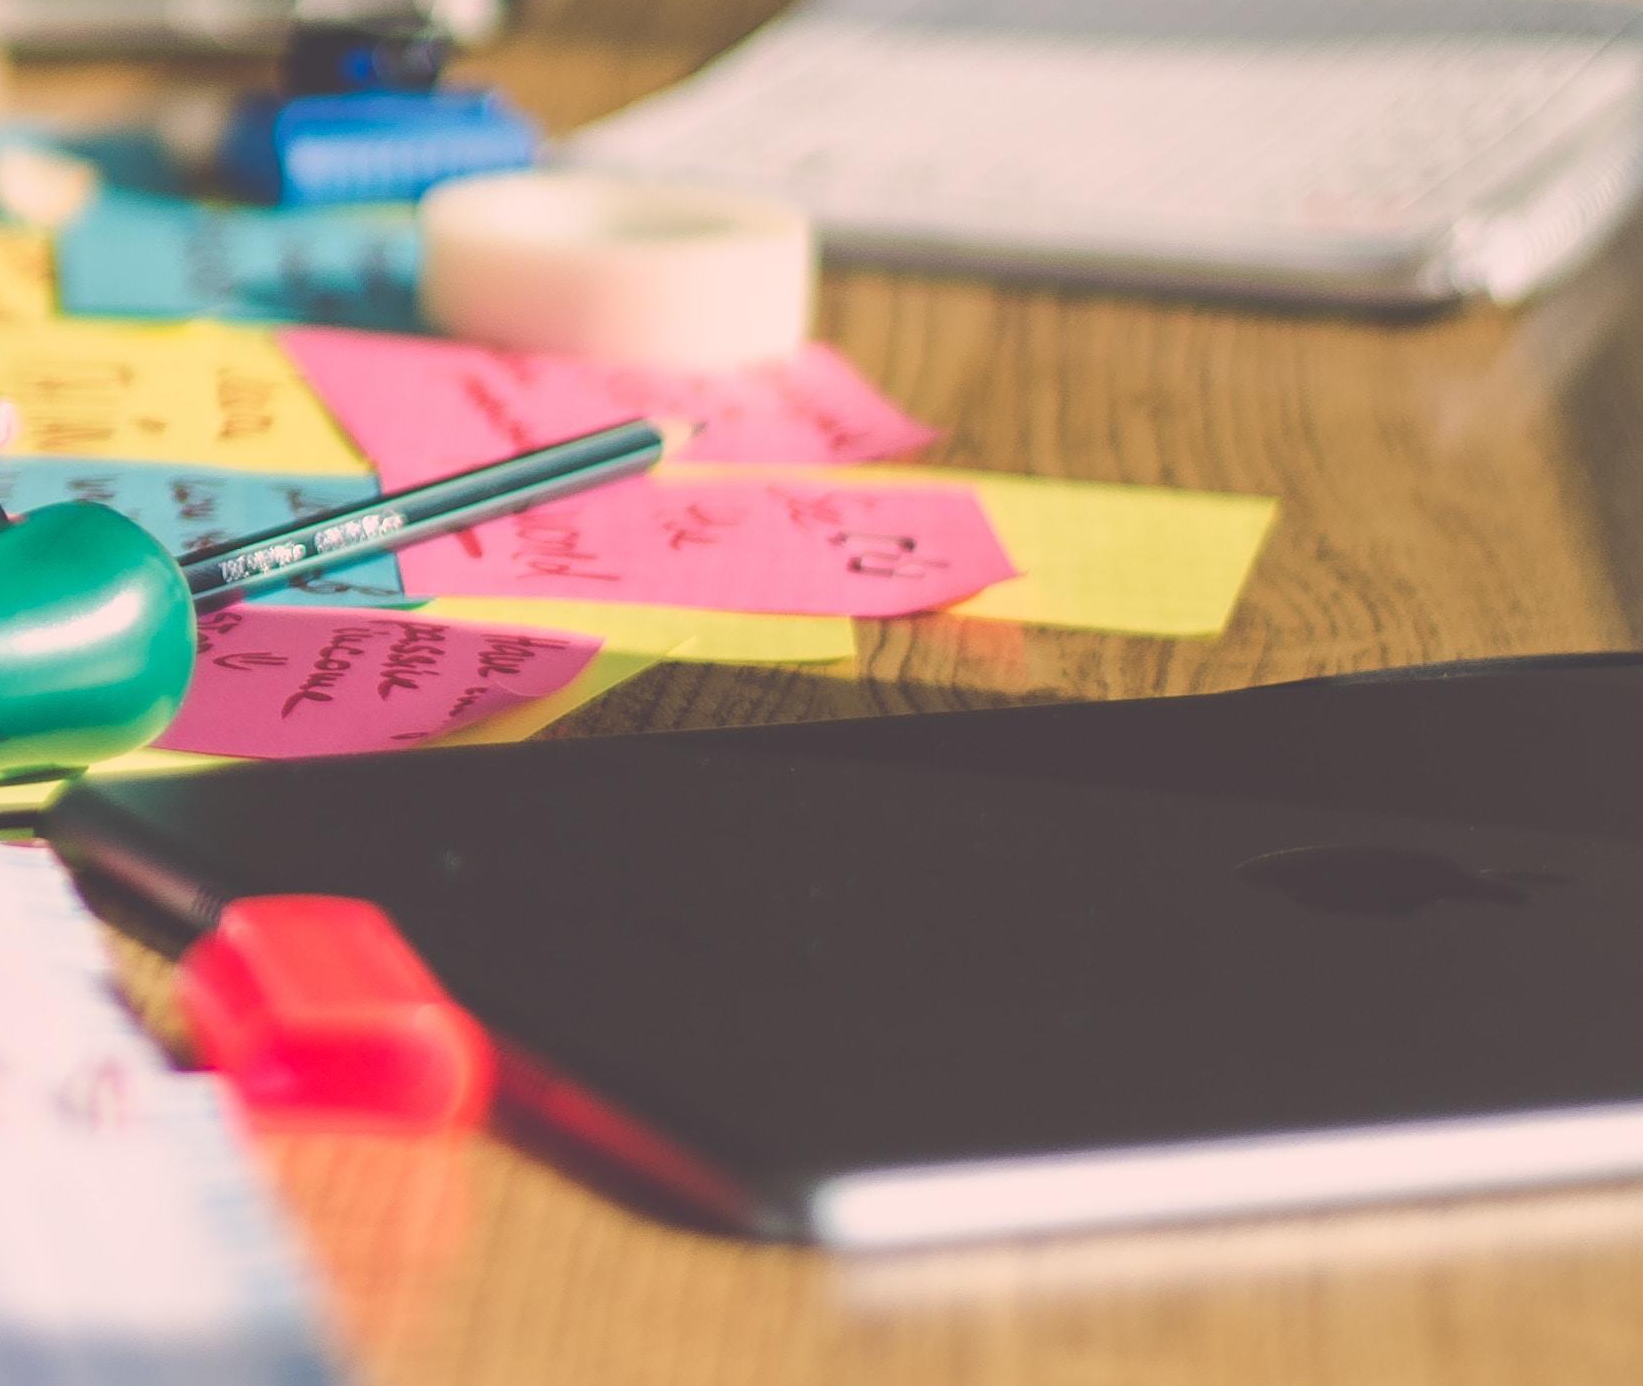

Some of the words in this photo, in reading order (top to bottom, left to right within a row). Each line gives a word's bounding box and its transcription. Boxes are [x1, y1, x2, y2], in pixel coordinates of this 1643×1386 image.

[281, 626, 389, 720] income
[368, 620, 451, 701] passive
[478, 633, 572, 678] Have
